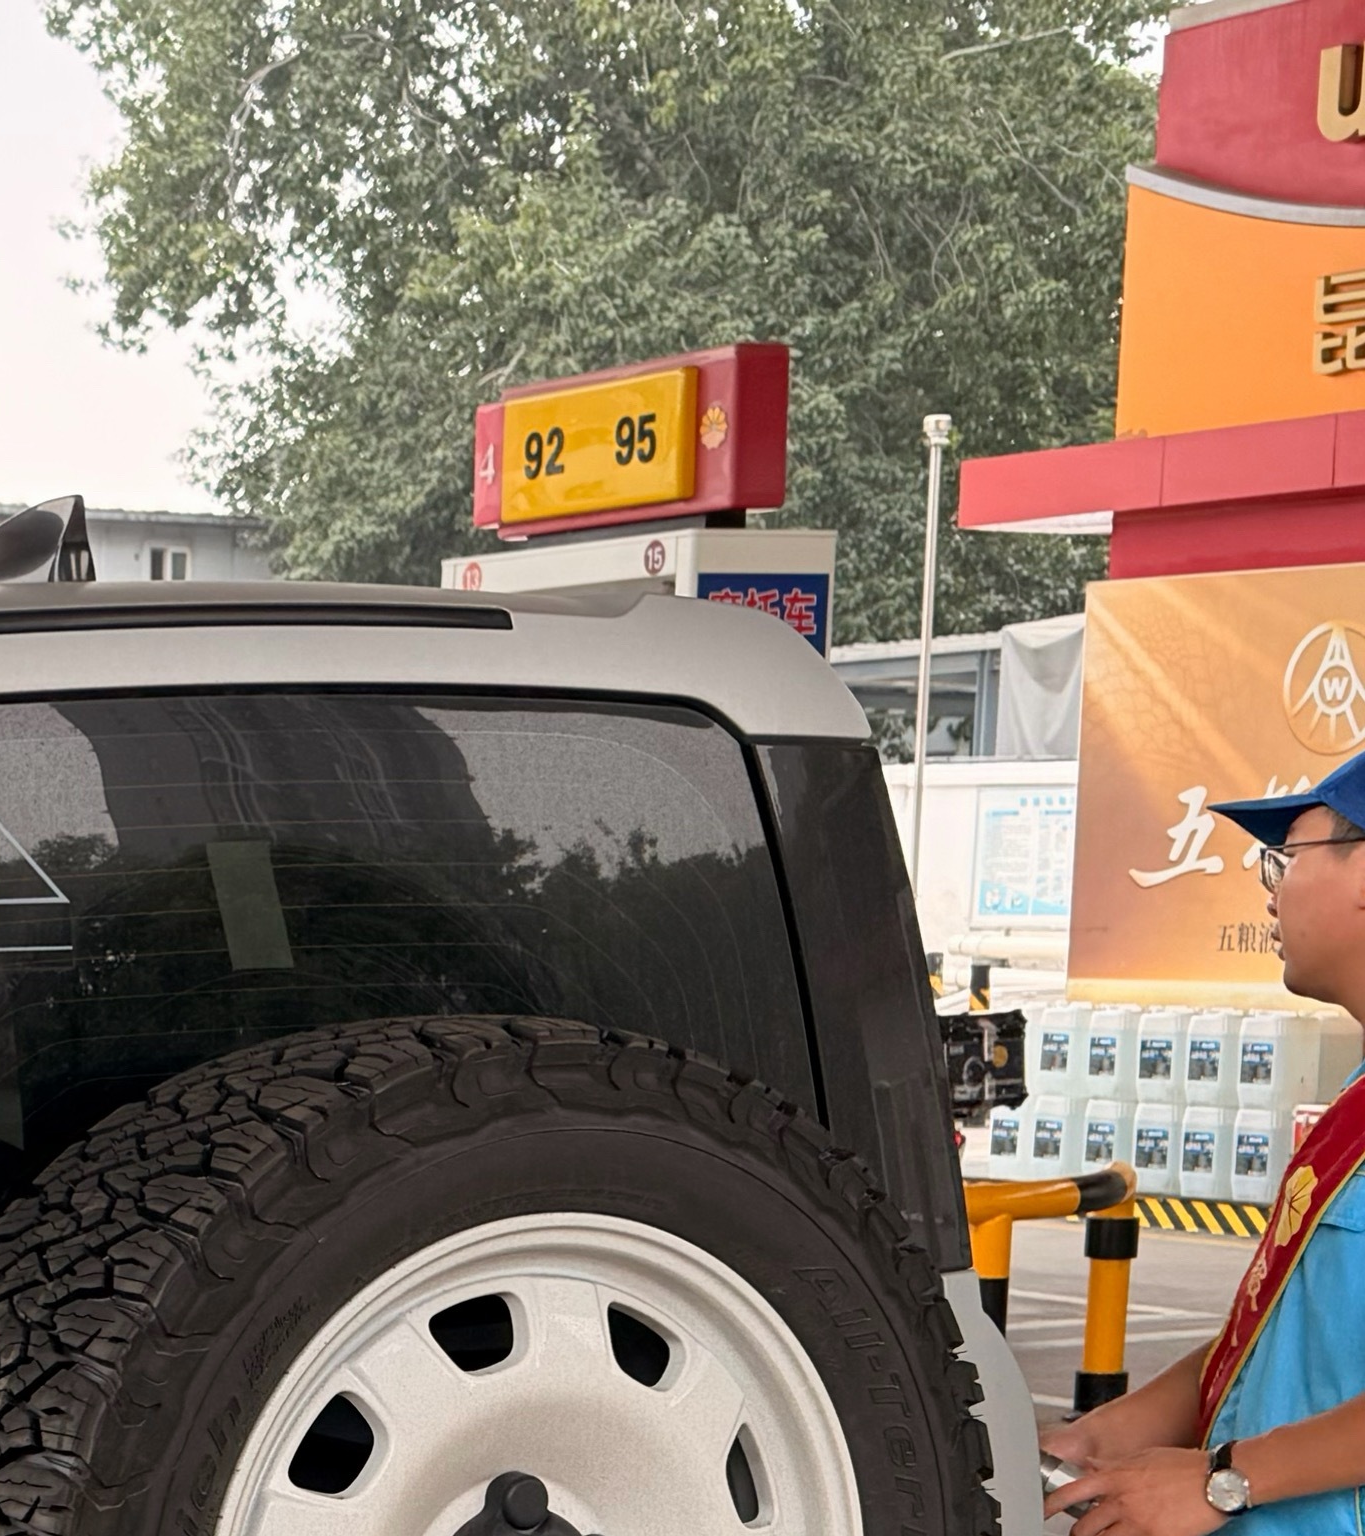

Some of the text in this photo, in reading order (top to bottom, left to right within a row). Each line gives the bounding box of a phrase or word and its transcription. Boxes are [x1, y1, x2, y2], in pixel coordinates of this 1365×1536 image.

[479, 443, 496, 485] 4
[524, 413, 657, 480] 92 95
[646, 547, 664, 570] 15
